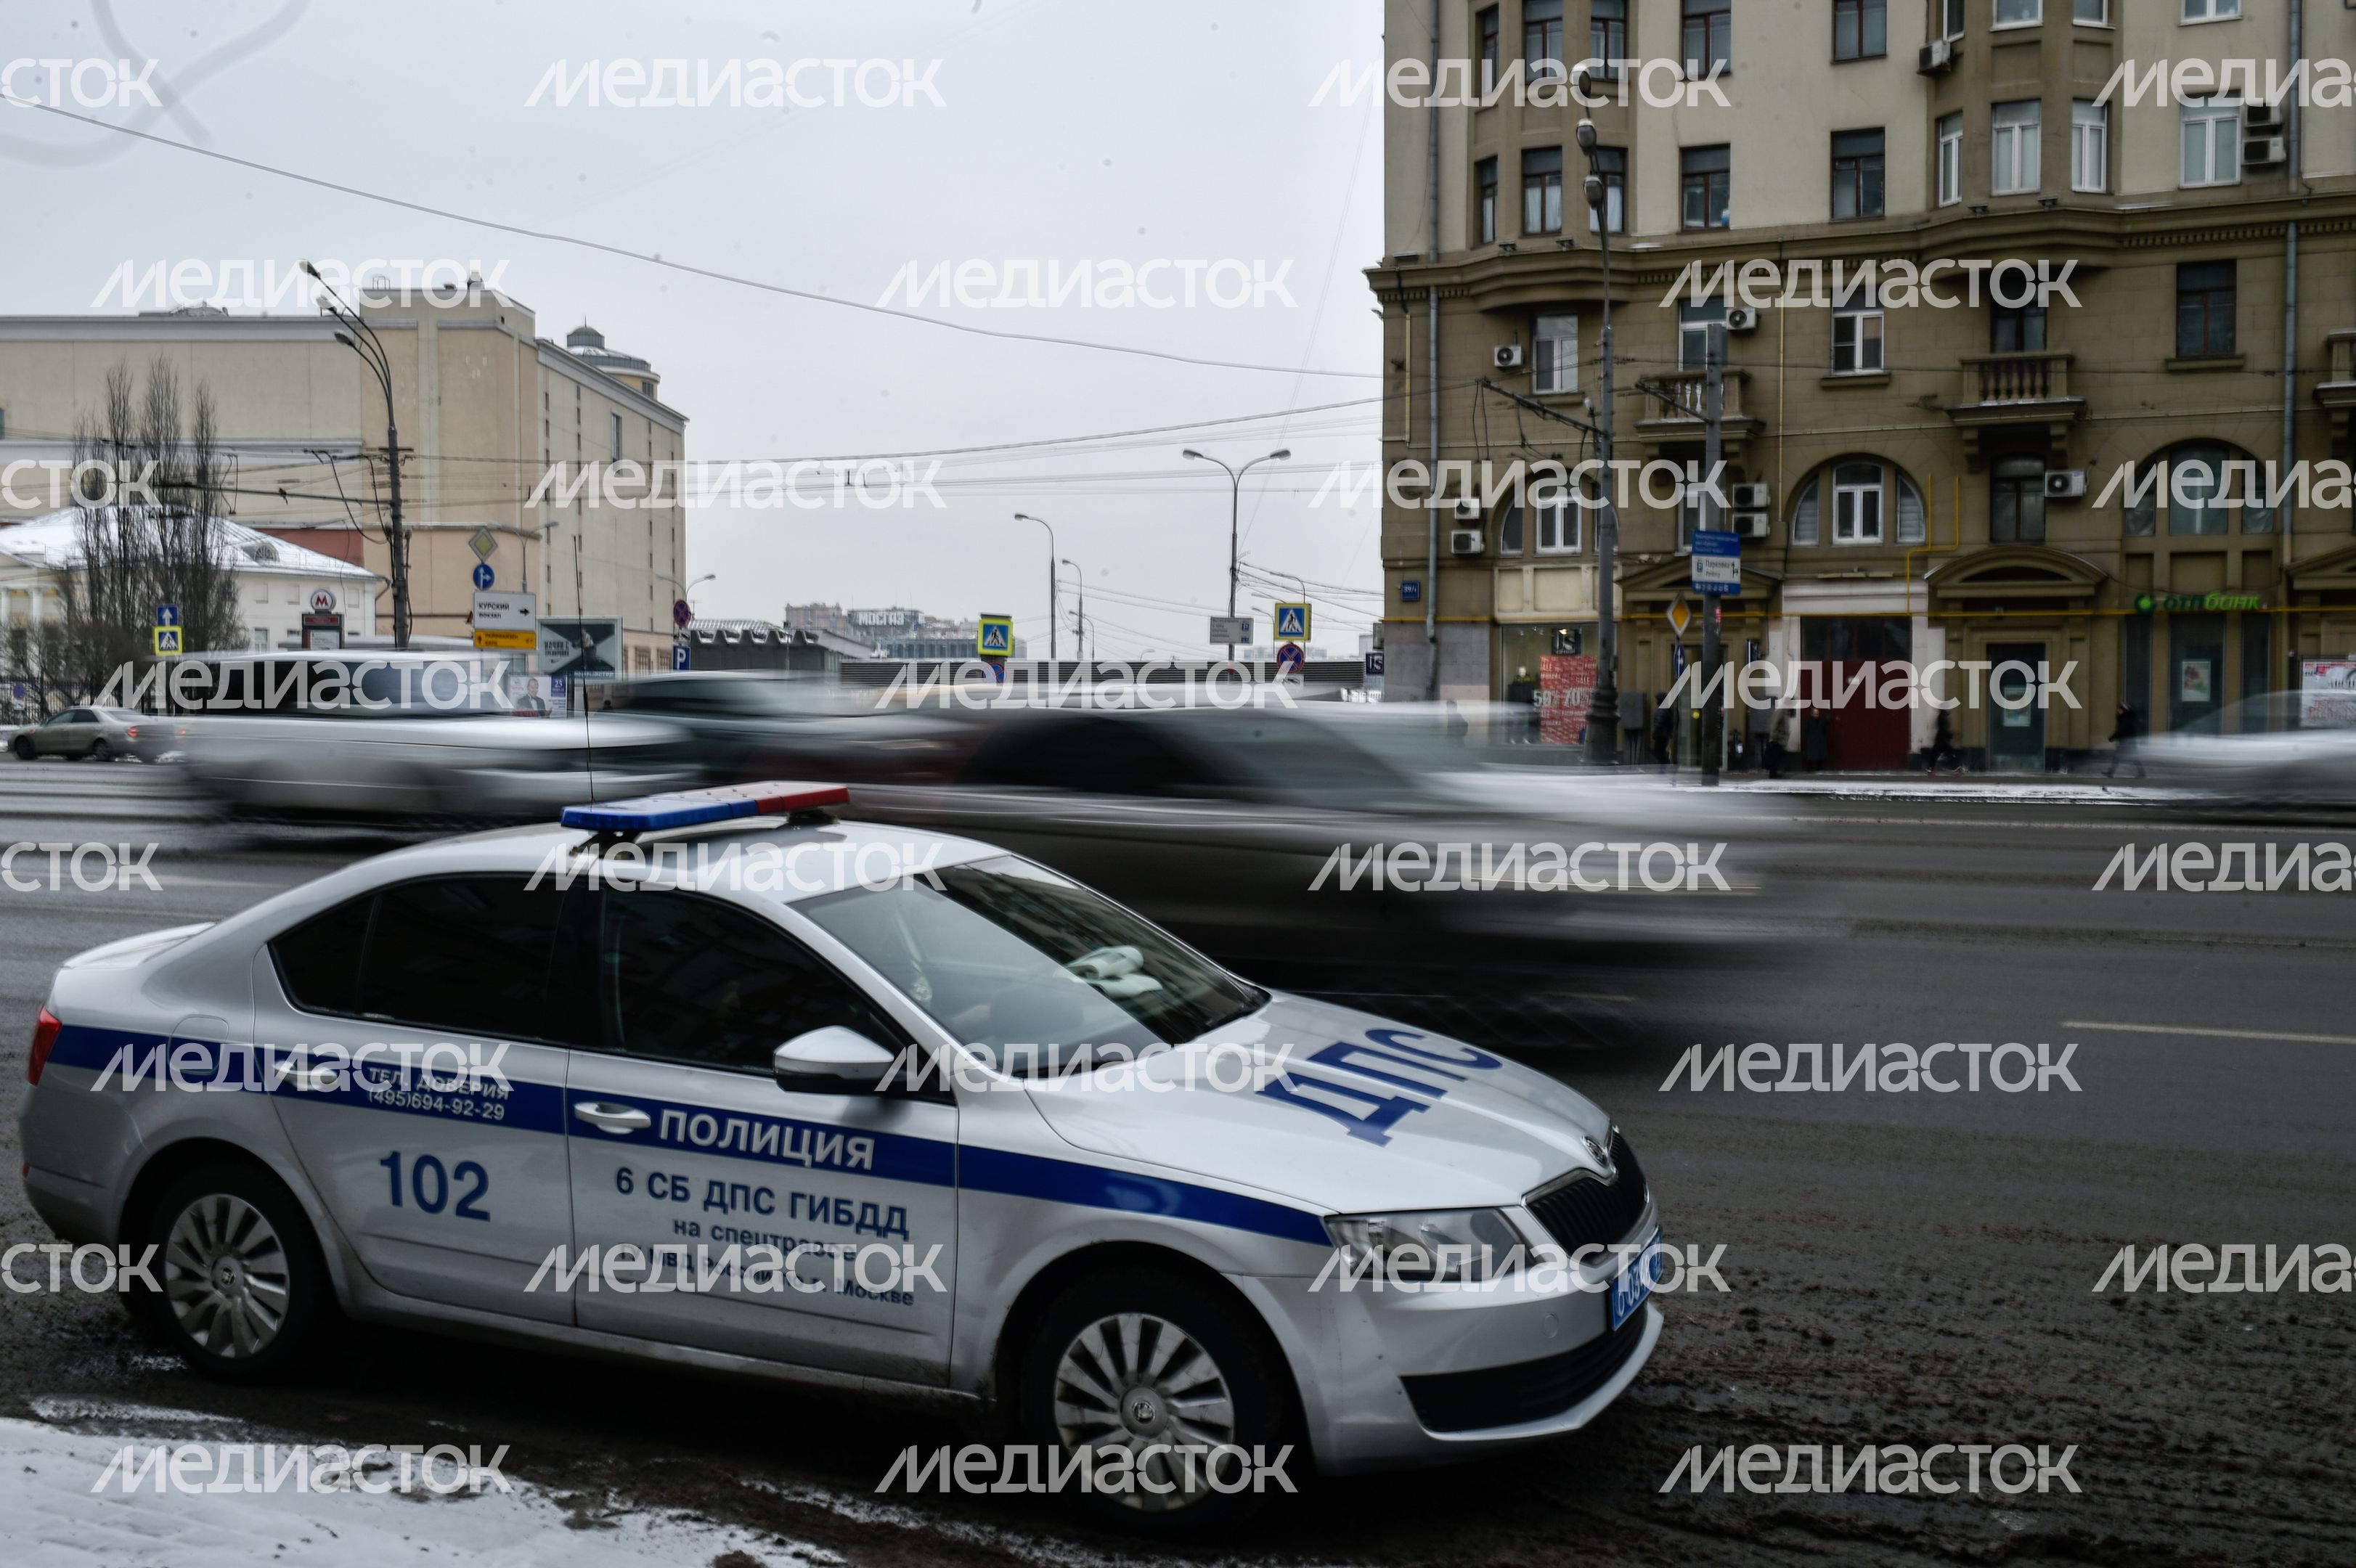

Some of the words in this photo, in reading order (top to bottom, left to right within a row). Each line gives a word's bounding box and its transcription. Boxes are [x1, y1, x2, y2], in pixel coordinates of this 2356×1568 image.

[1255, 1029, 1504, 1148] ДПС
[659, 1108, 875, 1170] ПОЛИЦИЯ
[380, 1151, 491, 1222] 102
[616, 1168, 634, 1195] 6
[647, 1172, 690, 1202] СБ
[704, 1180, 775, 1216] ДПС
[790, 1192, 909, 1241] ГИБДД
[673, 1219, 701, 1238] на
